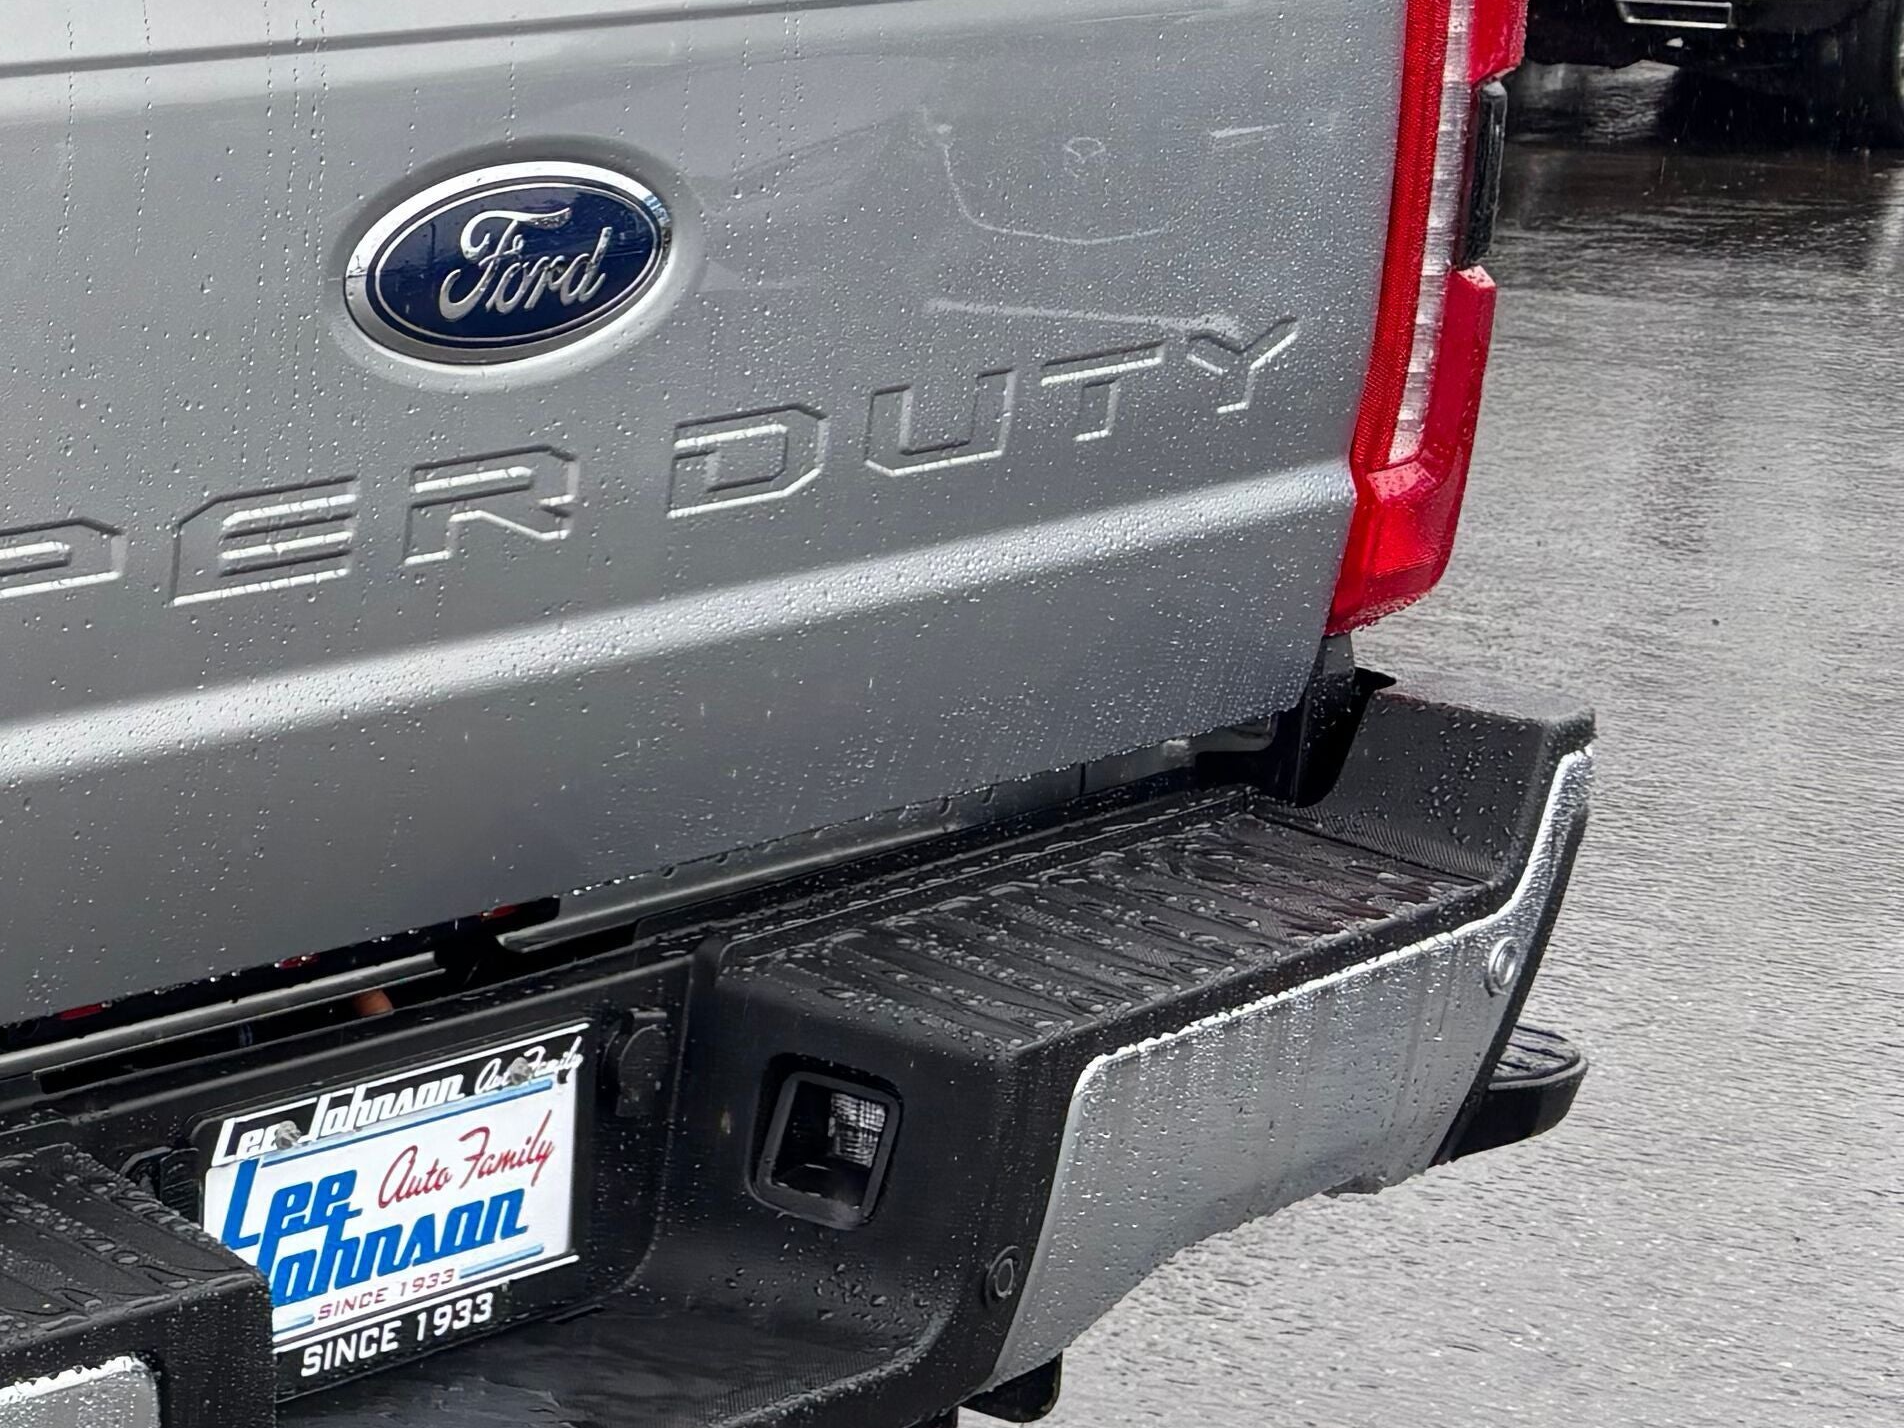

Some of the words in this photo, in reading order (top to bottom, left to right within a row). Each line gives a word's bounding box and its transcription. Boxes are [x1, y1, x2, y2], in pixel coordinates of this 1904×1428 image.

[438, 206, 613, 322] Ford
[666, 318, 1298, 521] DUTY
[298, 1073, 466, 1143] Johnson
[221, 1158, 359, 1251] Lee
[378, 1145, 452, 1209] Auto
[458, 1110, 557, 1188] Family
[301, 1324, 399, 1377] SINCE
[416, 1292, 495, 1343] 1933
[317, 1286, 390, 1321] SINCE
[399, 1268, 455, 1298] 1933
